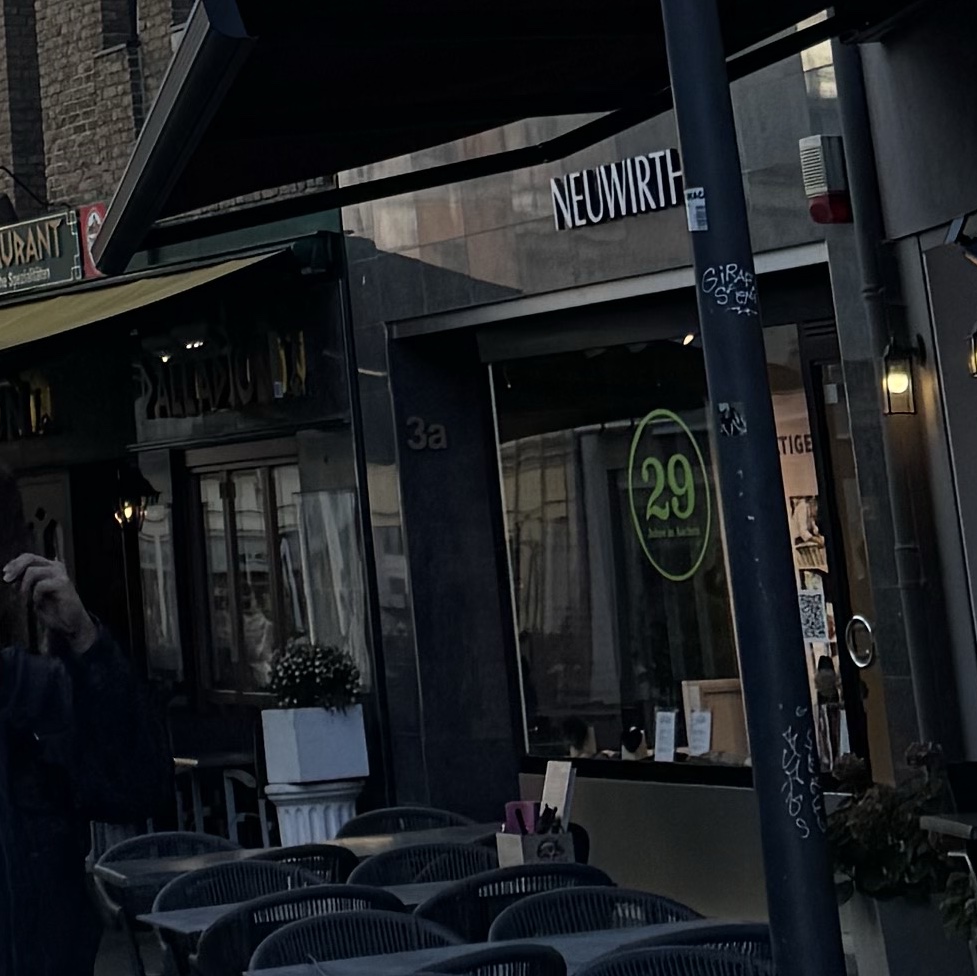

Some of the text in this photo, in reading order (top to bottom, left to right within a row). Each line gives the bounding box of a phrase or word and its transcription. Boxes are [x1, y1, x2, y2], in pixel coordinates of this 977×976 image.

[549, 148, 685, 231] NEUWIRTH
[406, 415, 448, 450] 3a
[641, 452, 696, 522] 29
